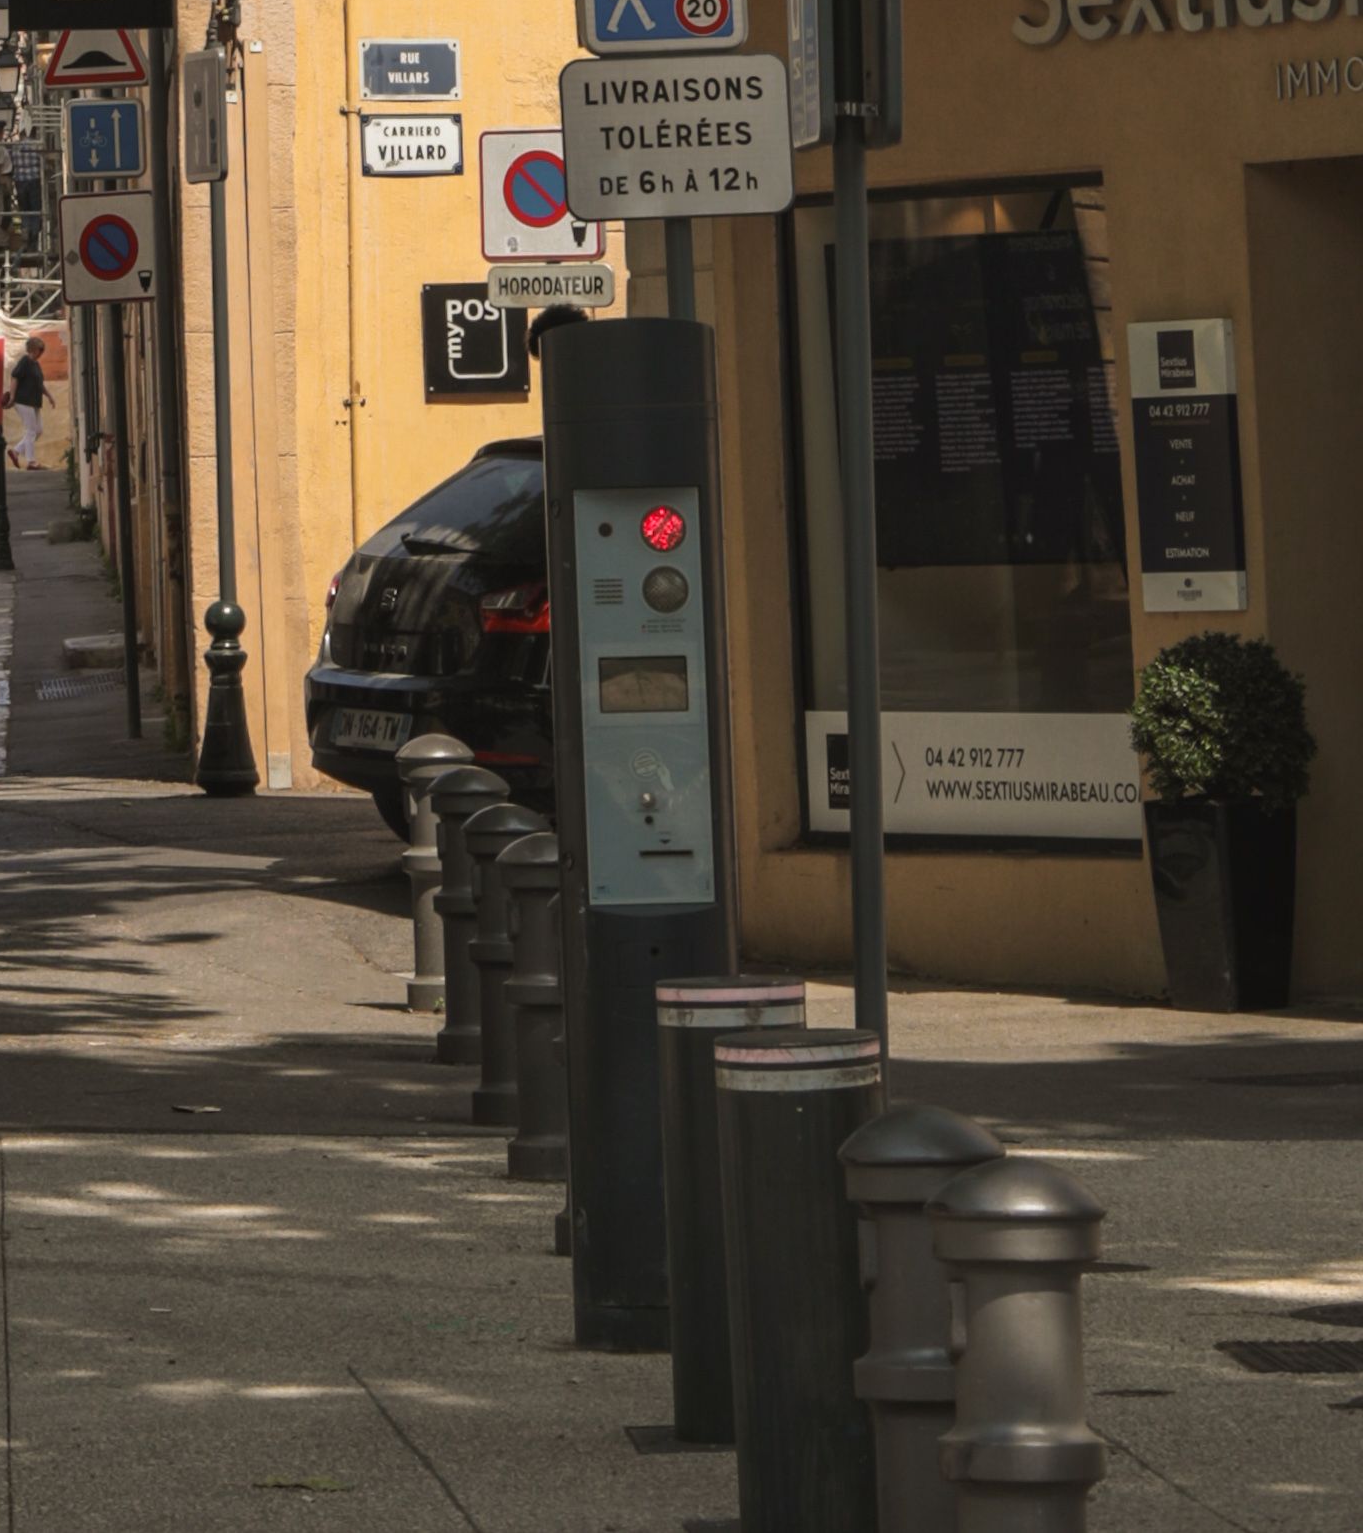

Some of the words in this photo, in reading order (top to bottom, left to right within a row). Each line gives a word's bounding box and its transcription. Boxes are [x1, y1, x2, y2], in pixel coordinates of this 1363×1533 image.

[400, 52, 420, 64] RUE
[387, 72, 430, 84] VILLARS
[584, 76, 763, 105] LIVRAISONS
[383, 126, 441, 137] CARRIERO
[600, 117, 752, 150] TOLÉRÉES
[378, 145, 446, 161] VILLARD
[600, 176, 629, 196] DE
[685, 169, 698, 193] À
[498, 276, 603, 296] HORODATEUR
[1160, 357, 1187, 367] Sextius
[1161, 369, 1194, 378] Mirabeau
[1149, 405, 1161, 417] 04
[1162, 404, 1174, 417] 42
[1175, 403, 1190, 417] 912
[1192, 402, 1210, 416] 777
[1169, 438, 1193, 449] VENTE
[1170, 474, 1195, 486] ACHAT
[1175, 511, 1195, 522] NEUF
[1165, 547, 1210, 558] ESTIMATION
[925, 747, 943, 768] 04
[947, 747, 965, 768] 42
[969, 747, 993, 768] 912
[997, 748, 1025, 769] 777
